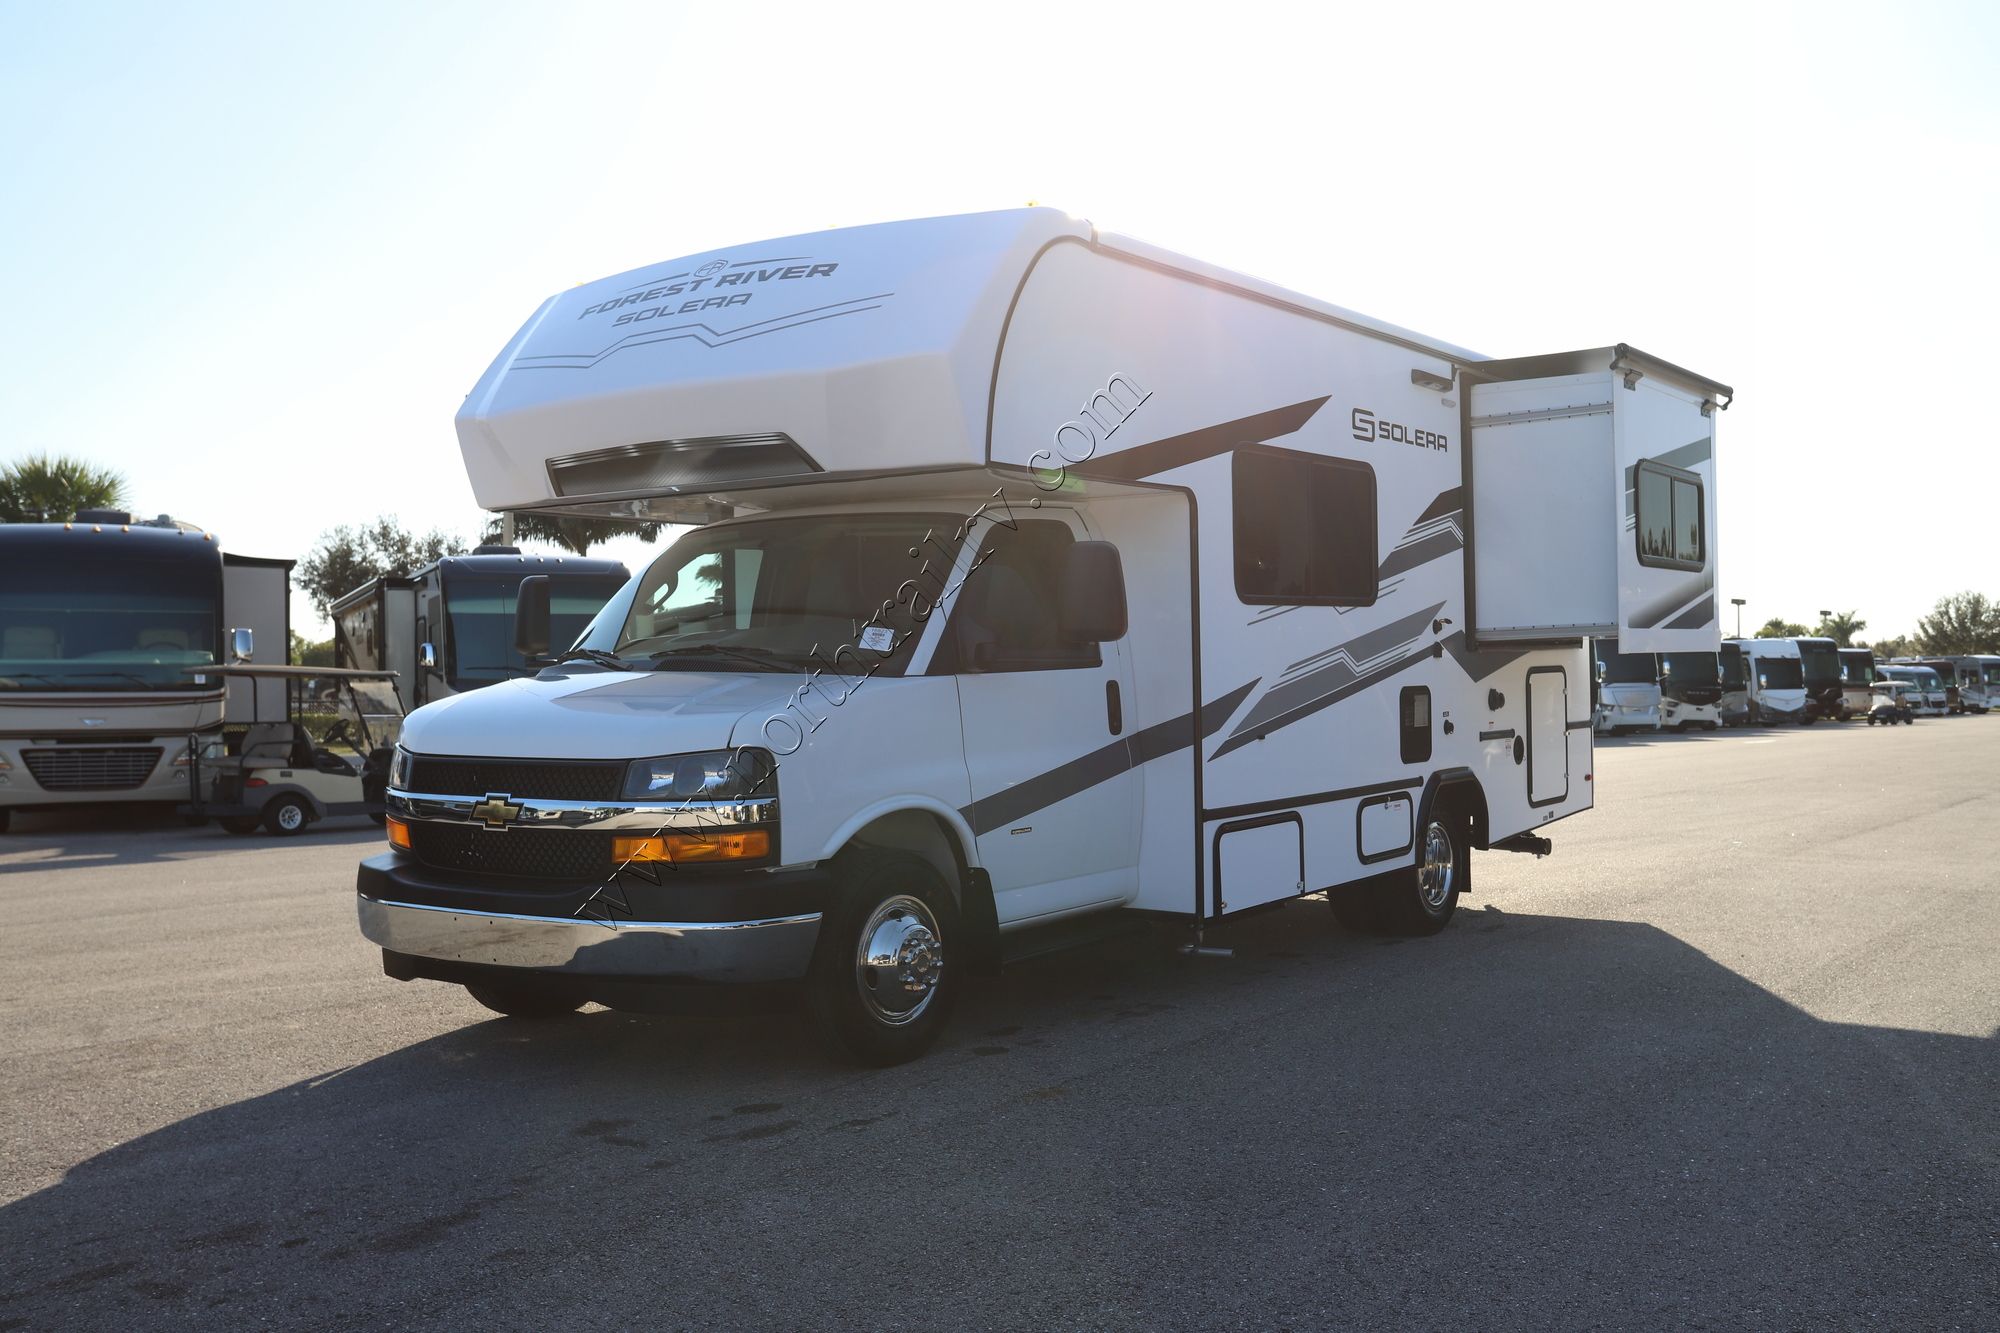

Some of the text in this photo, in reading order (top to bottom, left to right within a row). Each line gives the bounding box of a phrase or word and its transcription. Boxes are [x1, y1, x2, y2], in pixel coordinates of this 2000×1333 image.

[578, 263, 839, 320] FOREST RIVER
[611, 293, 752, 327] SOLERA
[1379, 420, 1448, 453] SOLERA
